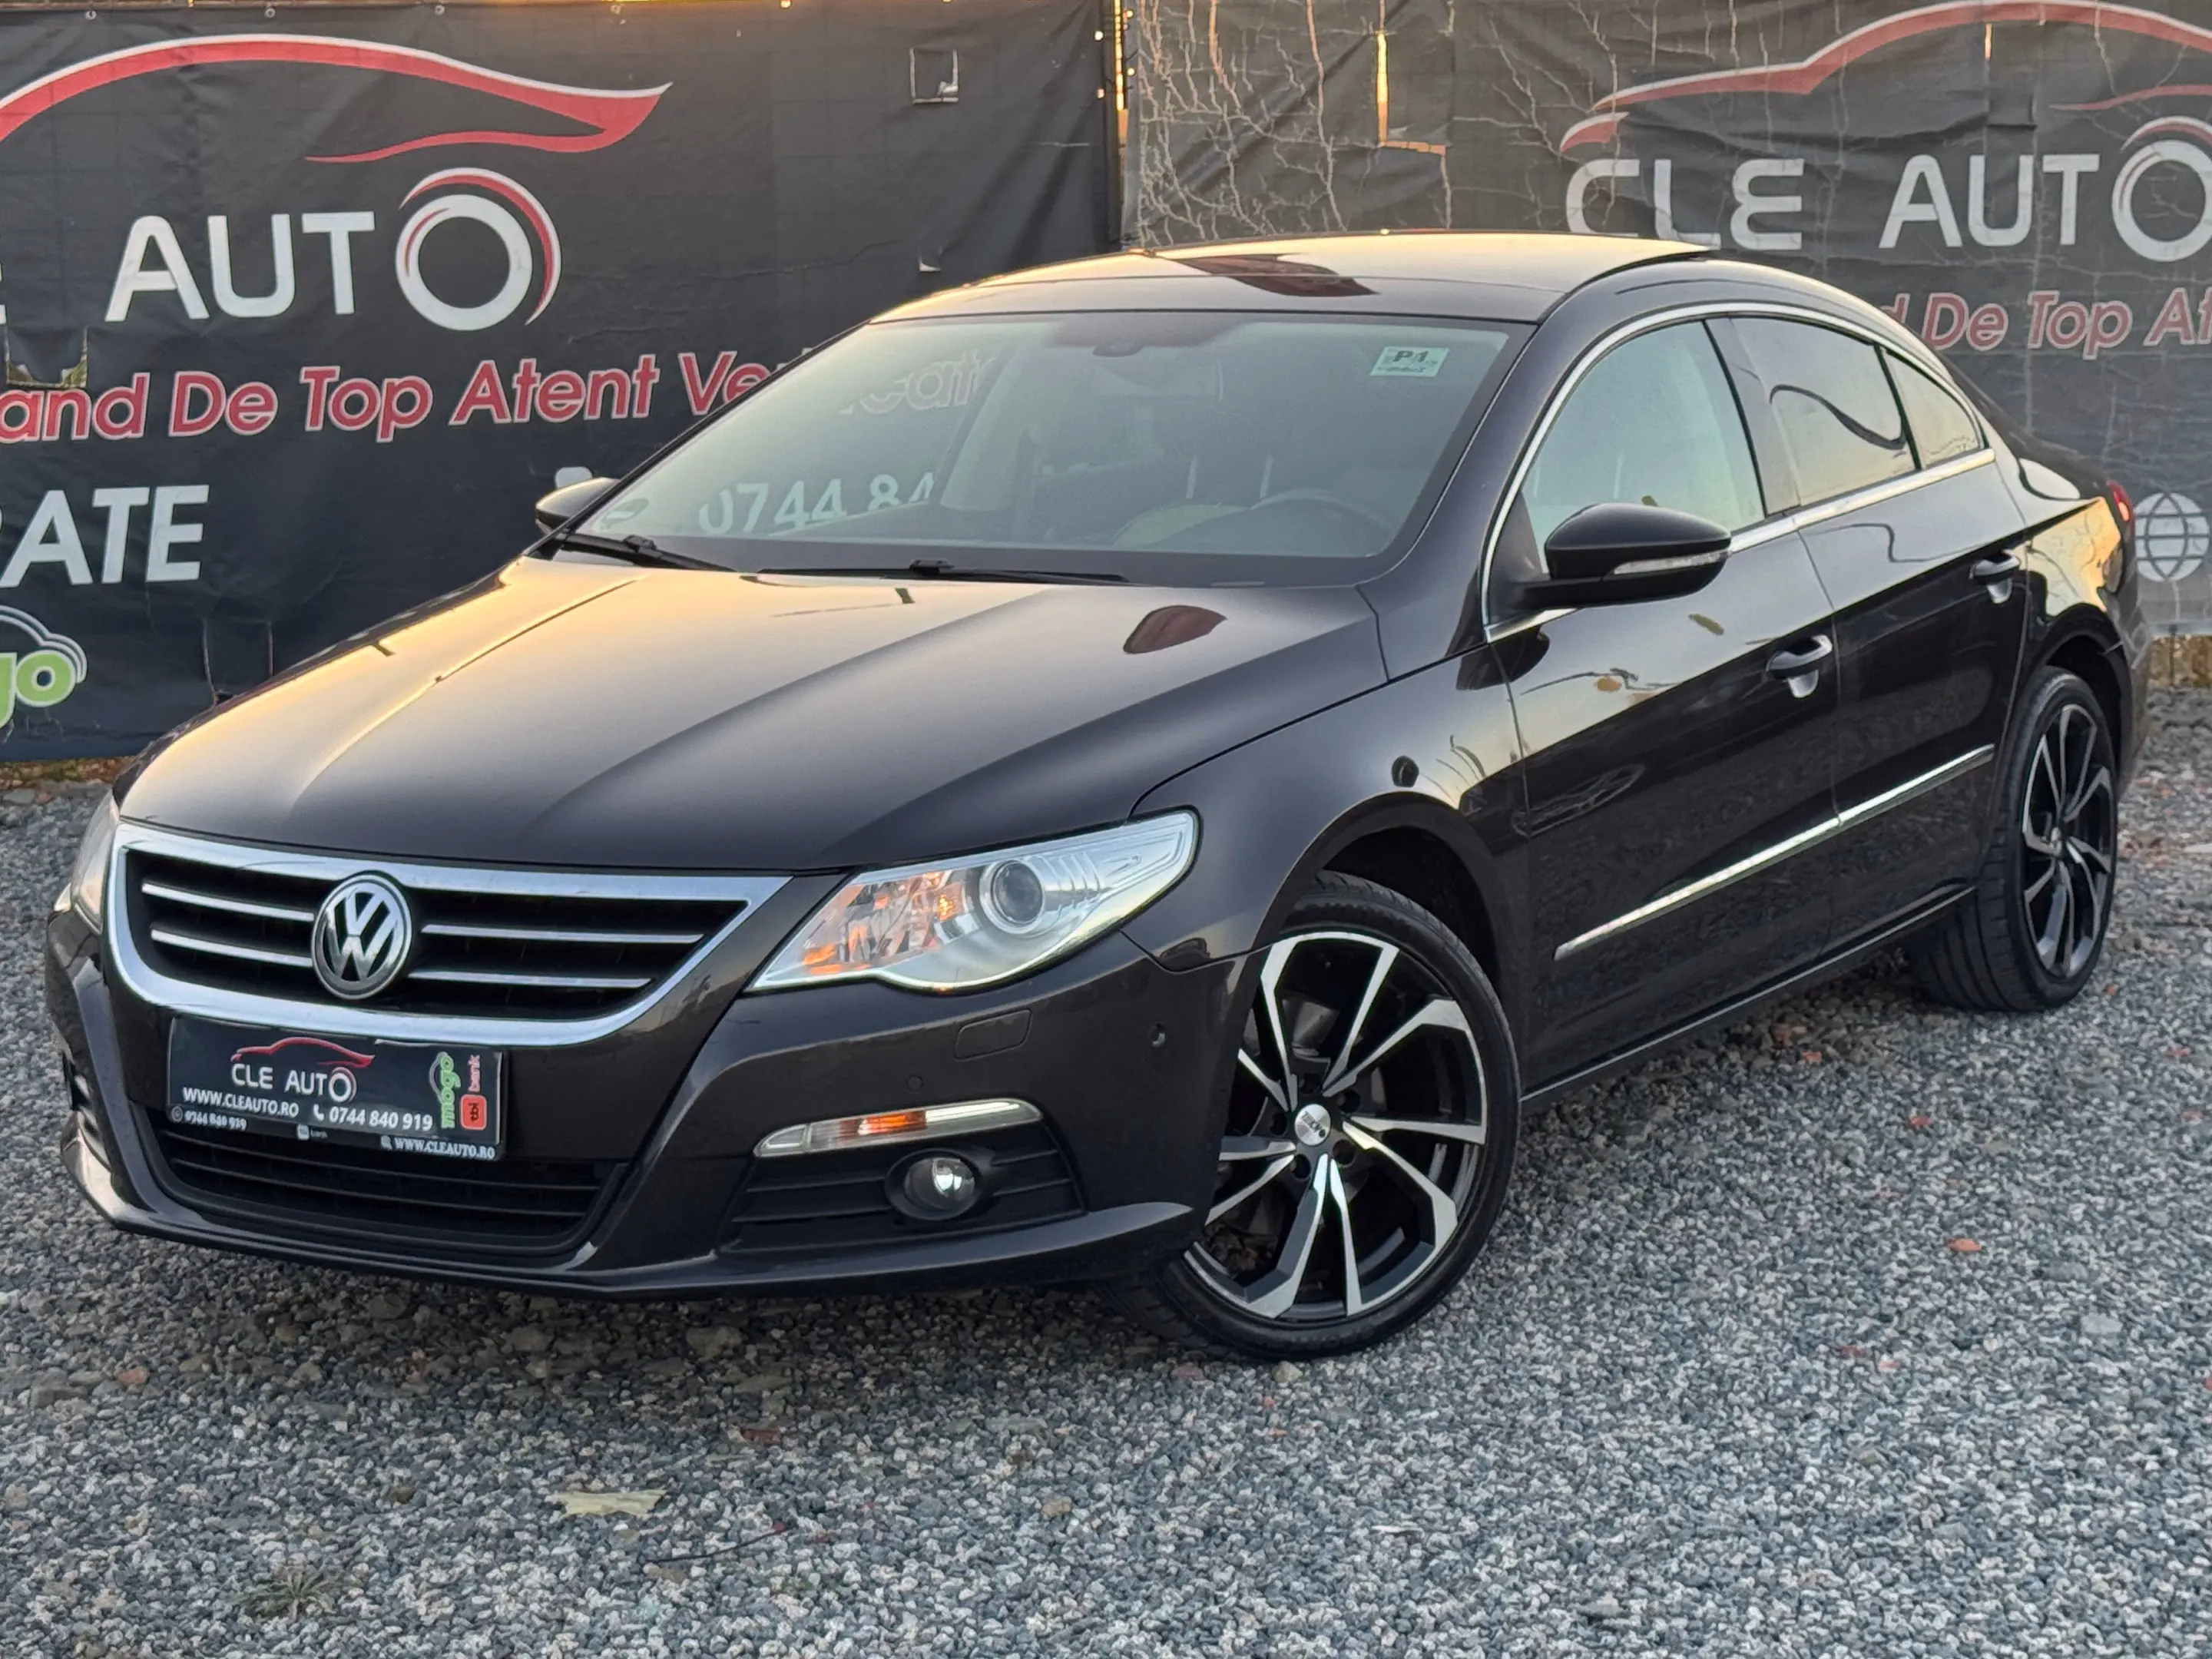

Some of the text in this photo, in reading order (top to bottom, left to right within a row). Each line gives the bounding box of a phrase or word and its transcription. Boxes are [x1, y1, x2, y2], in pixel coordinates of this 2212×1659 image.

[1566, 140, 2212, 262] CLE AUTO
[104, 194, 533, 331] AUTO
[1922, 293, 2009, 351] De
[2027, 290, 2134, 360] Top
[168, 371, 278, 437] De
[300, 366, 432, 442] Top
[449, 353, 661, 426] Atent
[0, 484, 210, 588] ATE
[182, 1087, 300, 1118] WWW.CLEAUTO.RO
[231, 1062, 353, 1103] CLE AUTO
[329, 1106, 433, 1131] 0744 840 919
[441, 1055, 461, 1128] mogo
